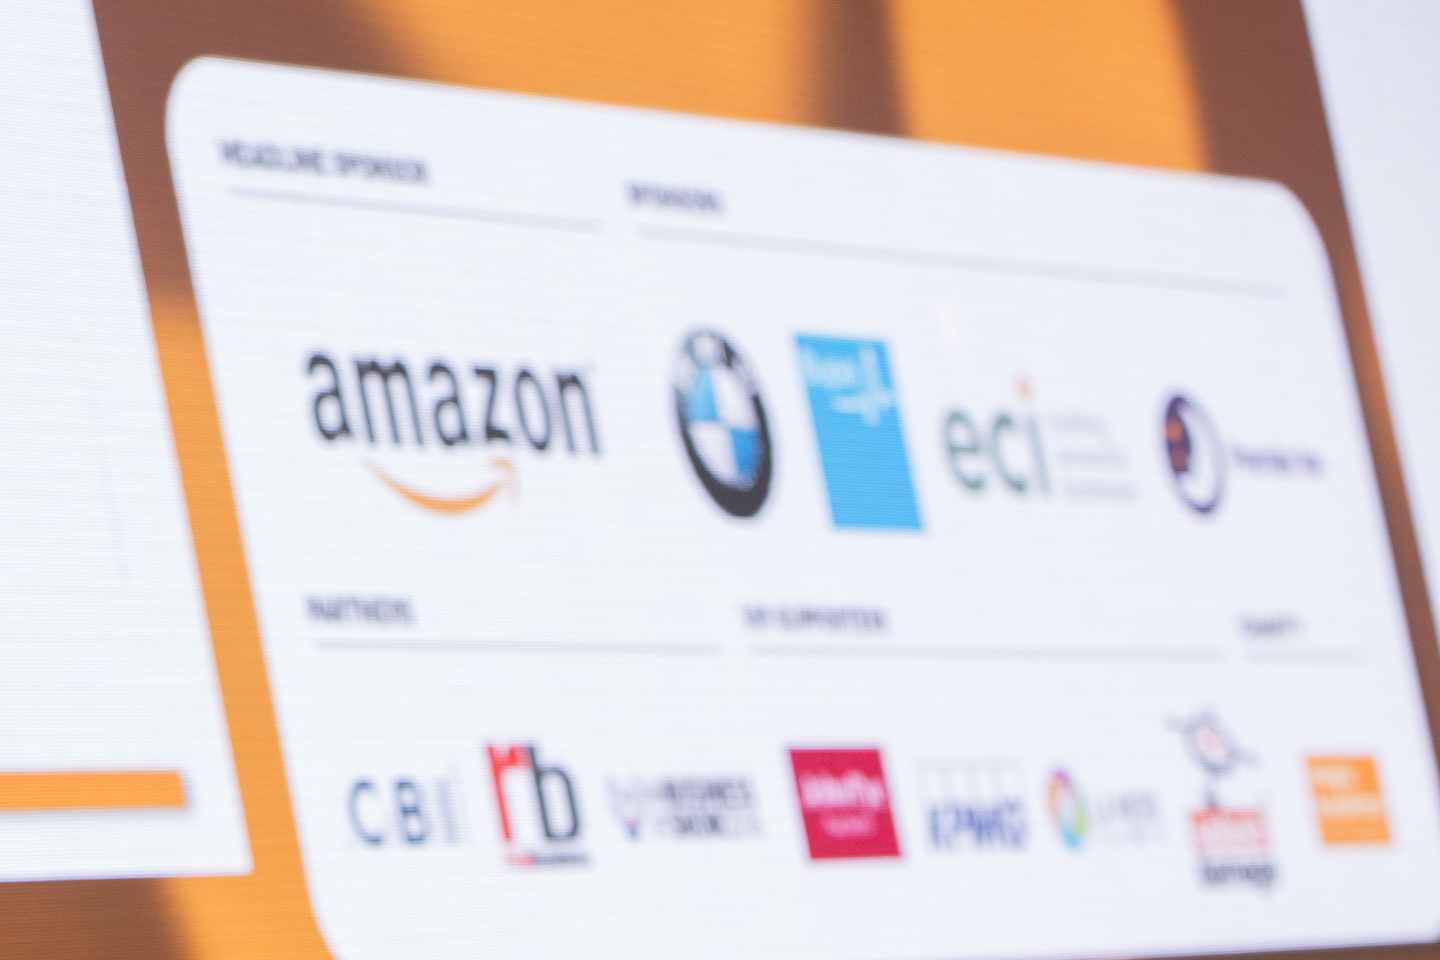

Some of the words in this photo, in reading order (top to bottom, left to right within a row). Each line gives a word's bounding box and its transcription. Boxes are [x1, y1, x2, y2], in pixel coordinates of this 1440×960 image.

[305, 350, 600, 459] amazon
[942, 376, 1050, 496] eci
[348, 776, 458, 845] CBI
